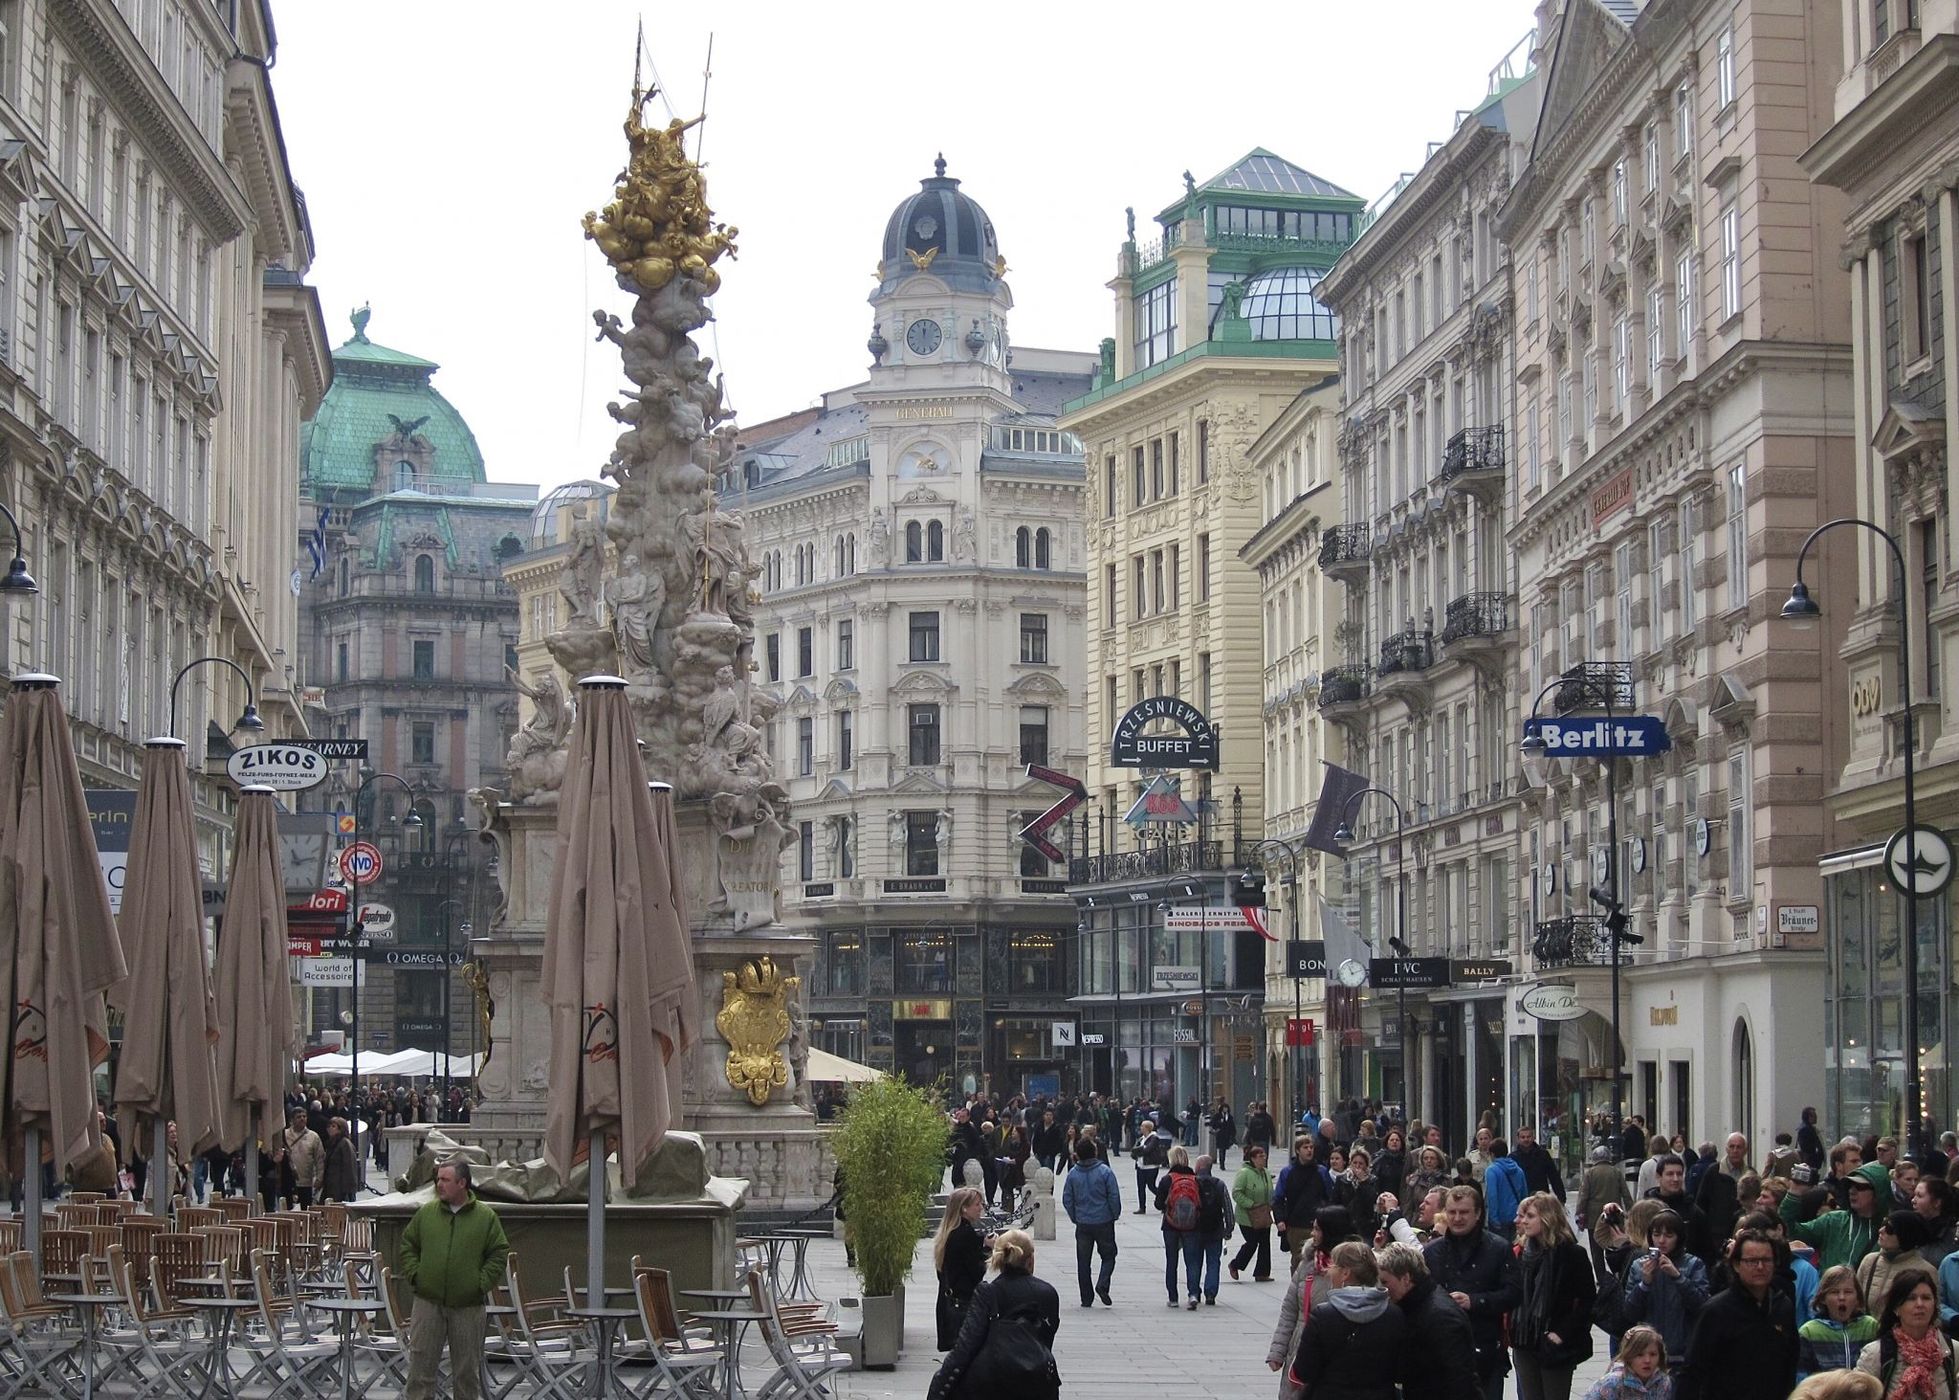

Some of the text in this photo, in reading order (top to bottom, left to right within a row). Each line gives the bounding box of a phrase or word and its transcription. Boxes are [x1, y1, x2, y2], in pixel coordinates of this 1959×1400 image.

[1541, 722, 1645, 749] Berlitz
[1137, 740, 1192, 753] BUFFET
[240, 749, 317, 770] ZIKOS
[402, 953, 445, 964] OMEGA
[314, 964, 353, 972] World of
[1463, 967, 1495, 975] BALLY
[304, 971, 353, 980] Accessoire
[1289, 1023, 1312, 1032] hgl
[1174, 1028, 1195, 1041] FOSSIL
